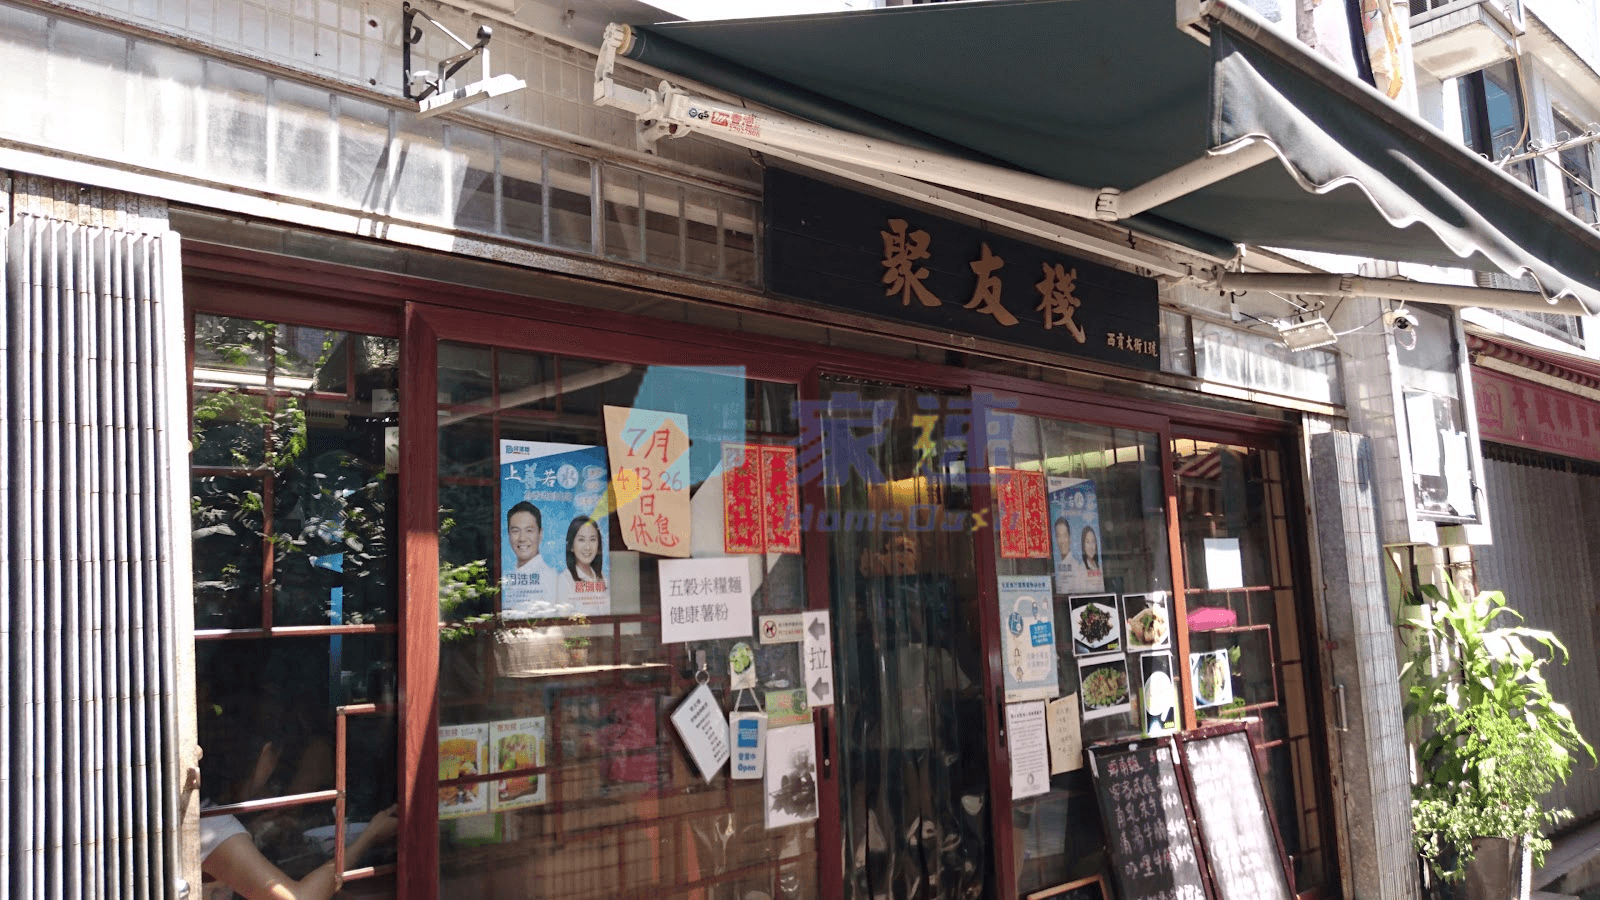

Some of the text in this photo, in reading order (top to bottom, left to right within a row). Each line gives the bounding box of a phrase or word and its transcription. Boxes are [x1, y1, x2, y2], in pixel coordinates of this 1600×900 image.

[880, 218, 1086, 344] 聚友棧
[1106, 332, 1158, 357] 西貢大街1號
[626, 427, 671, 463] 7月
[639, 493, 656, 516] 日
[630, 513, 680, 547] 休息
[670, 603, 728, 624] 健康薯粉
[809, 647, 828, 671] 拉
[738, 763, 757, 772] Open
